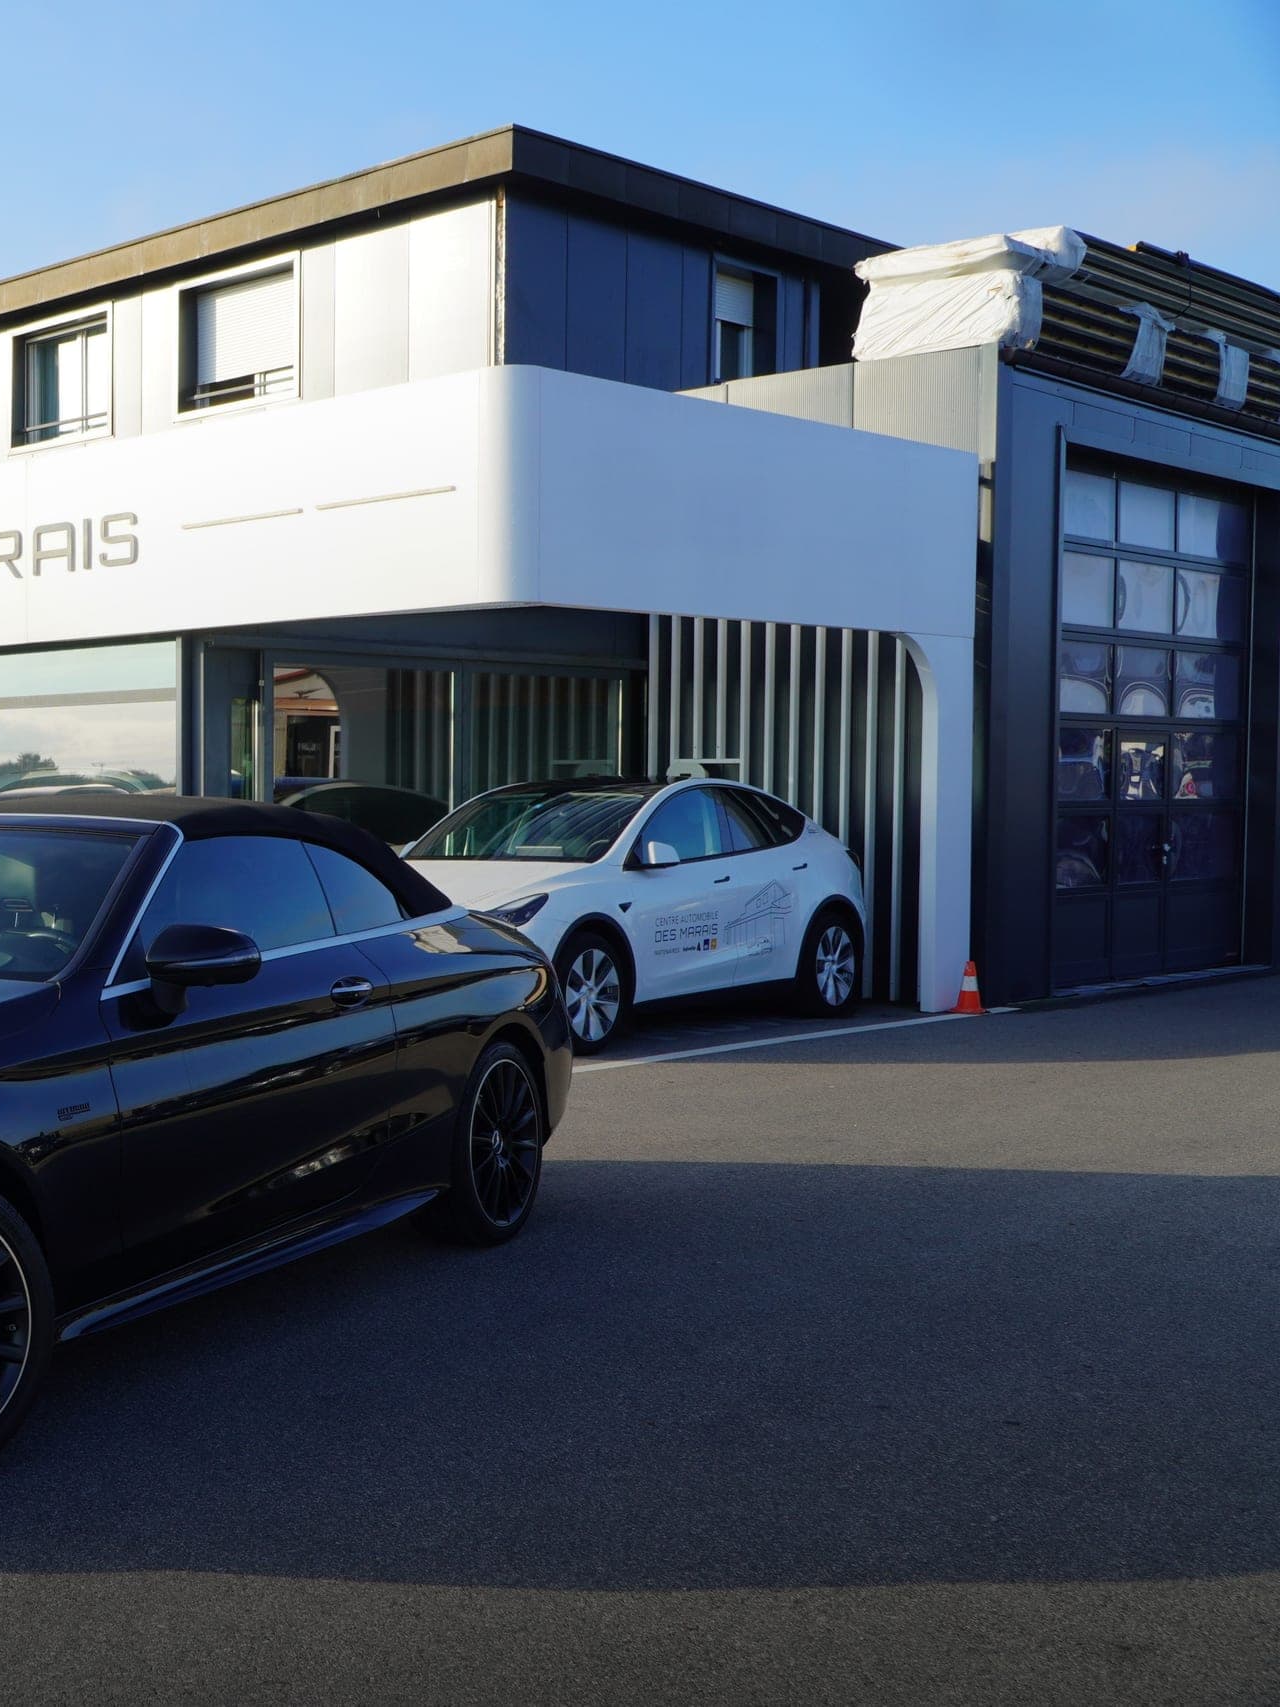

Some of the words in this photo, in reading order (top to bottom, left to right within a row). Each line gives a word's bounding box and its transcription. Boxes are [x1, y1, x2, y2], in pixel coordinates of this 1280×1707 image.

[655, 915, 680, 928] CENTRE
[680, 910, 720, 924] AUTOMOBILE
[654, 929, 677, 943] DES
[679, 923, 718, 941] MARAIS
